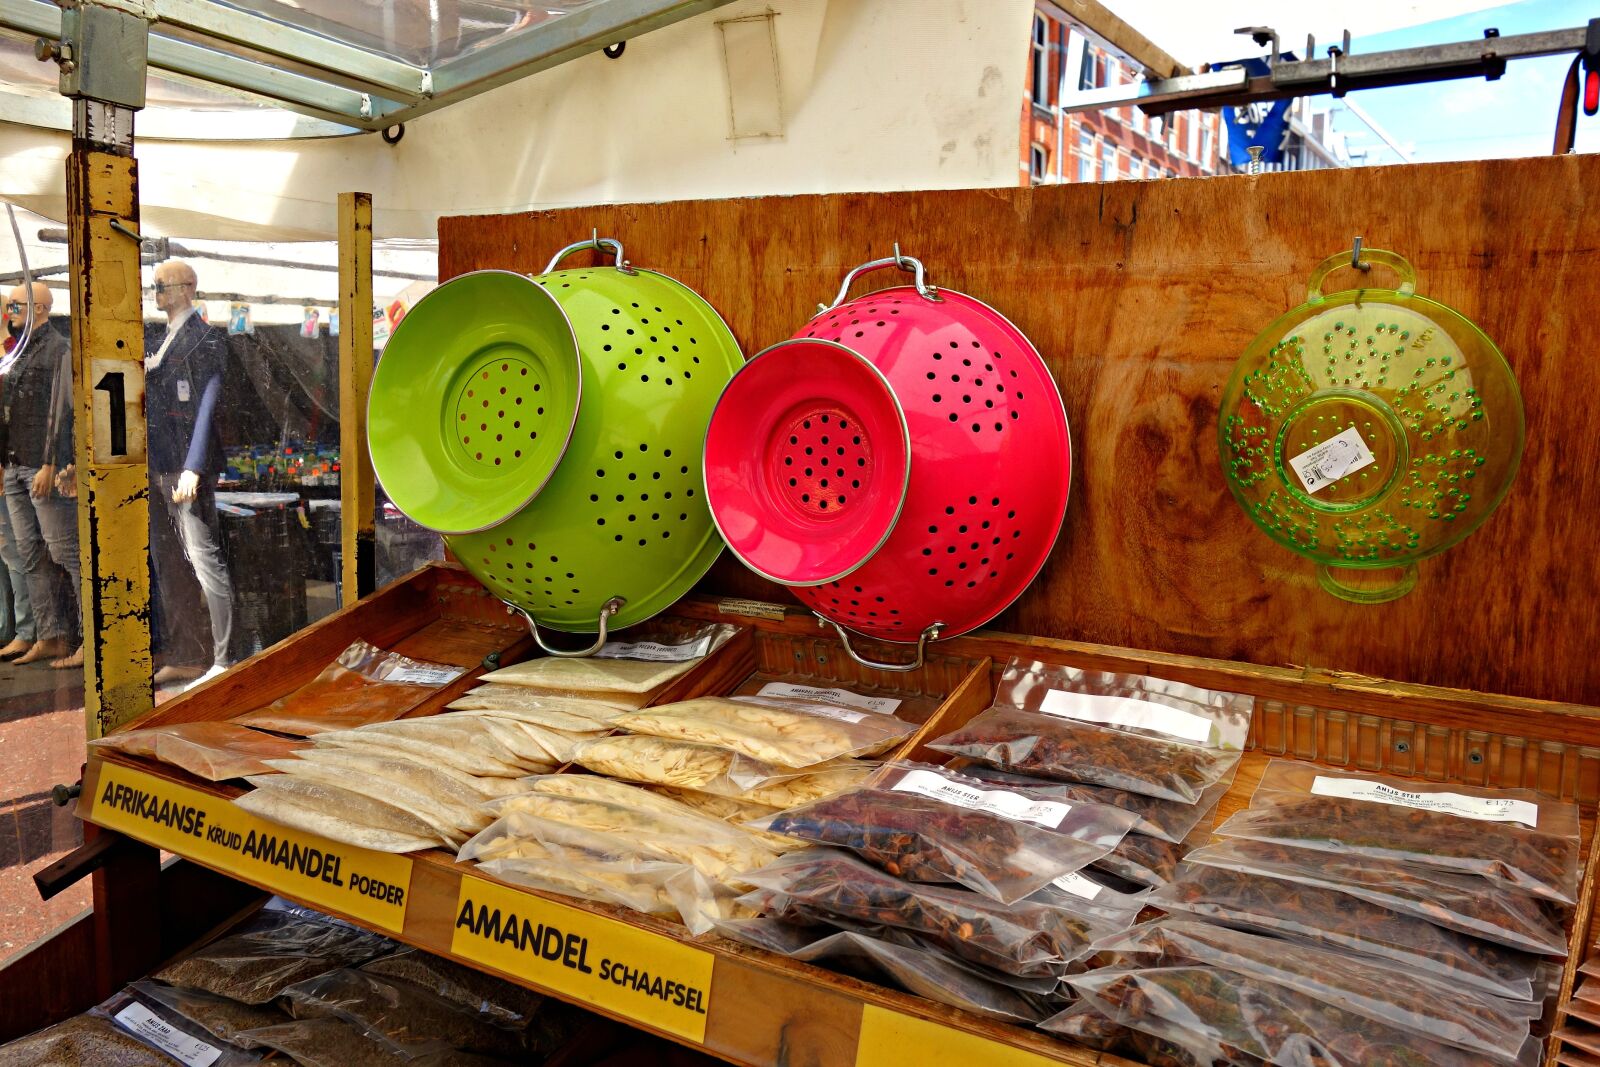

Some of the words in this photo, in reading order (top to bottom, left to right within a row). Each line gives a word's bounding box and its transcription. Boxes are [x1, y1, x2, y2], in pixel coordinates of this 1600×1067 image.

[94, 372, 127, 456] 1
[941, 785, 962, 795] ANIJS
[962, 792, 980, 801] STER
[1375, 785, 1399, 796] ANIJS
[1402, 792, 1421, 800] STER
[101, 780, 206, 838] AFRIKAANSE
[206, 824, 242, 851] KRUID
[241, 829, 343, 887] AMANDEL
[349, 873, 404, 907] POEDER
[456, 899, 593, 974] AMANDEL
[598, 958, 706, 1014] SCHAAFSEL
